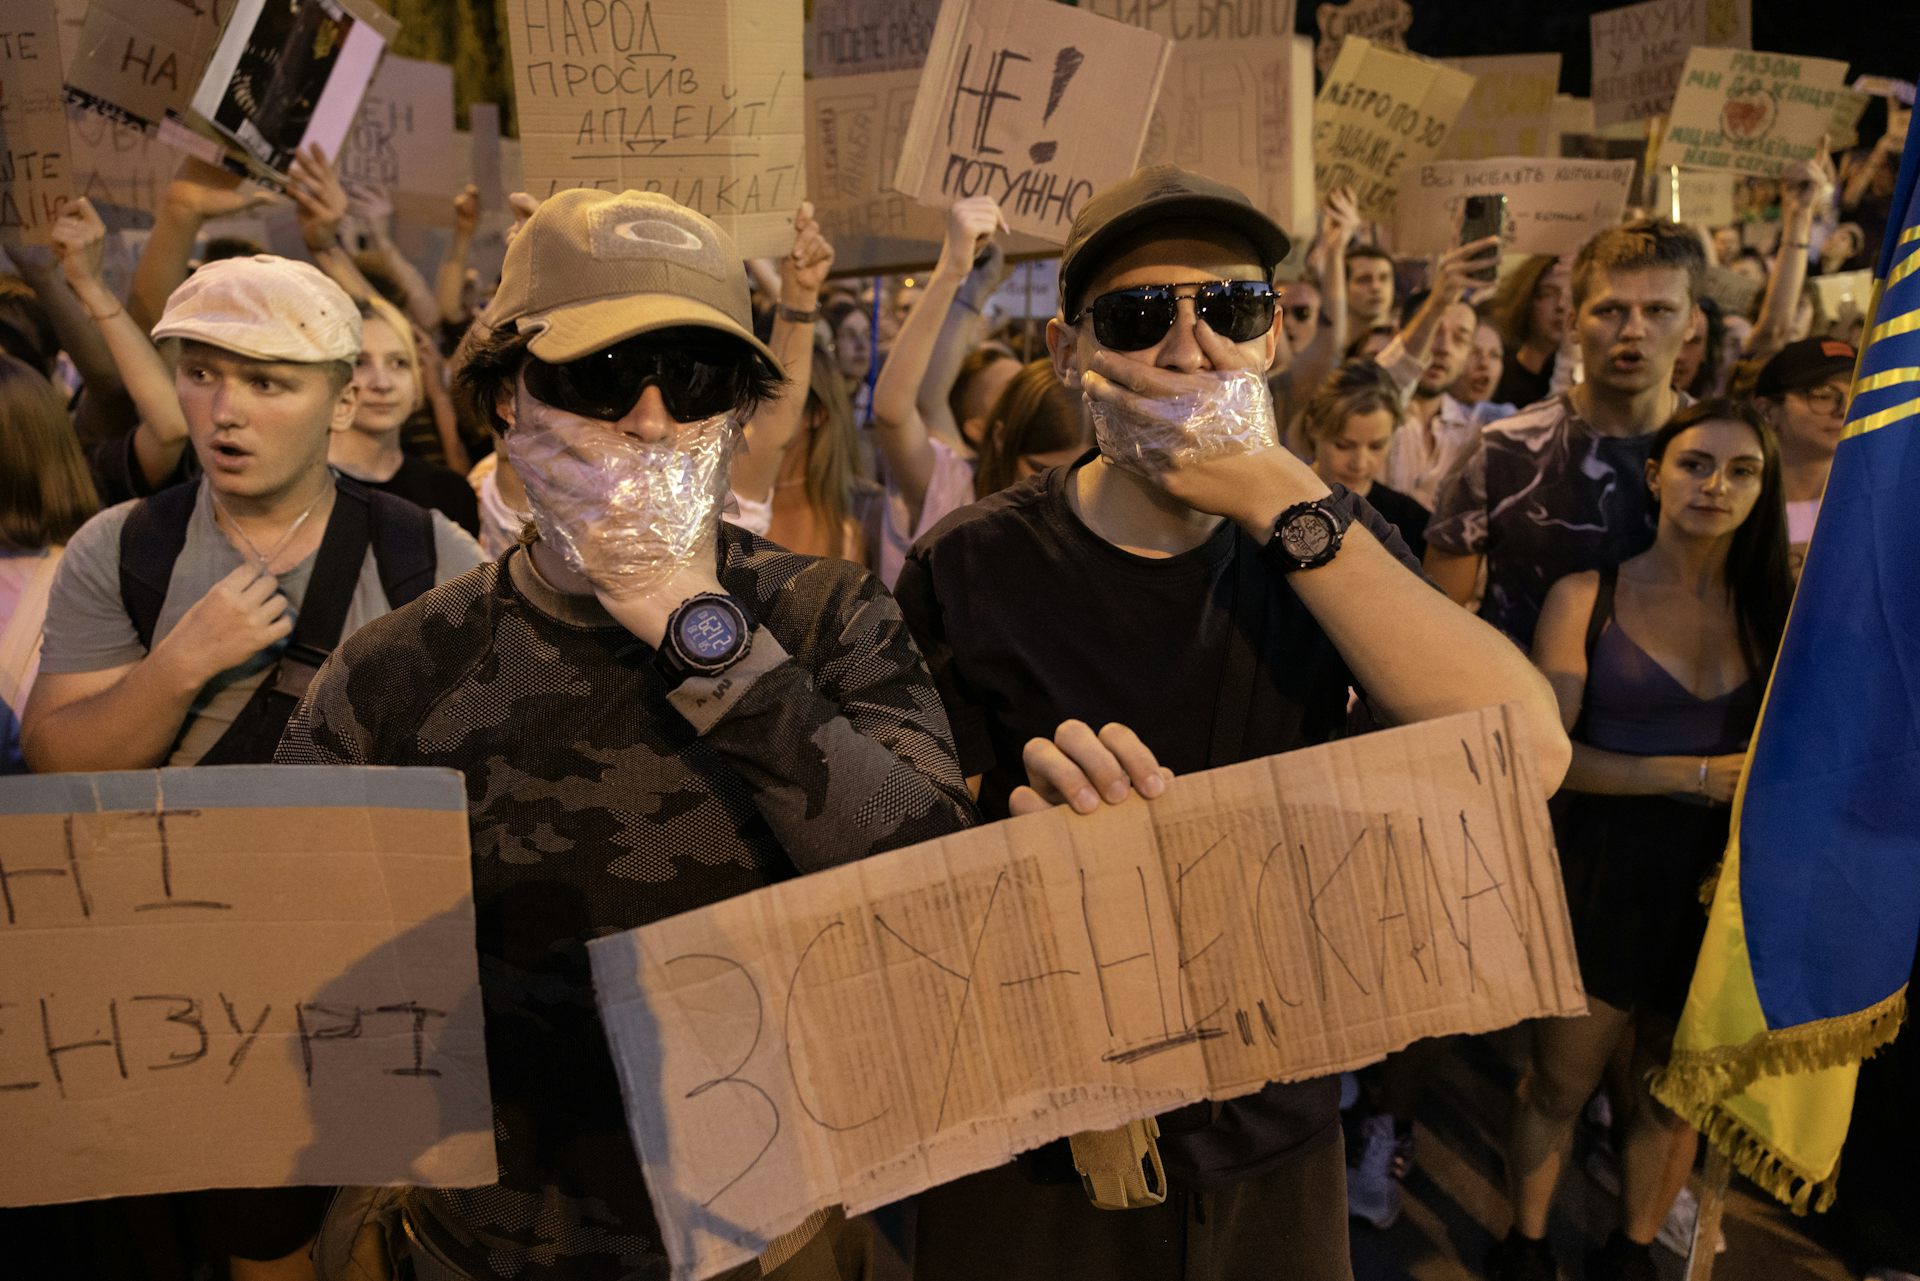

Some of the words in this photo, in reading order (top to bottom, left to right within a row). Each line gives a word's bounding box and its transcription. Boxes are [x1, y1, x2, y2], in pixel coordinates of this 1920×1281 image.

[525, 0, 677, 64] НАРОД
[120, 37, 178, 91] НА
[527, 61, 699, 99] ПРОСИВ
[664, 870, 1004, 1207] ЗСУ
